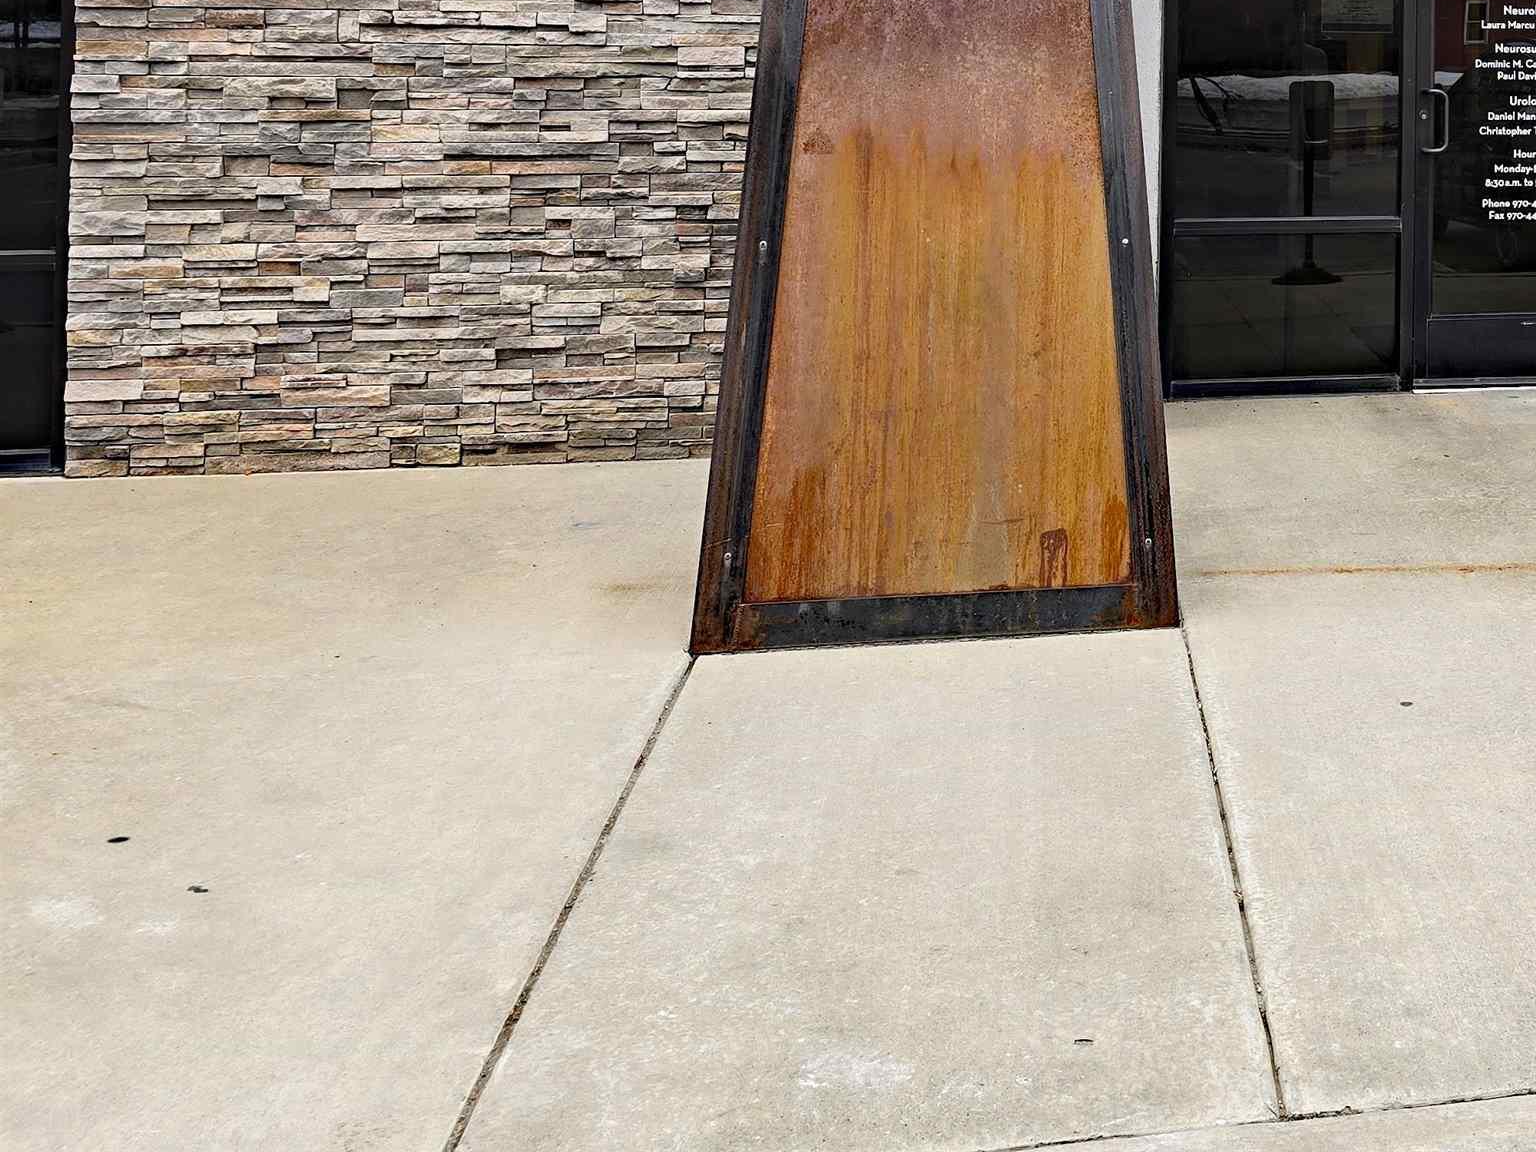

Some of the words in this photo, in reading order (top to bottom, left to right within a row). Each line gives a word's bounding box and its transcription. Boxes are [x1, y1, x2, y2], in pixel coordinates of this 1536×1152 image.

[1481, 20, 1506, 29] Laura
[1508, 20, 1535, 29] Marcu
[1475, 59, 1511, 68] Dominic
[1512, 59, 1523, 68] M.
[1497, 70, 1516, 80] Paul
[1487, 111, 1516, 120] Daniel
[1479, 125, 1532, 137] Christopher
[1524, 177, 1534, 187] to
[1482, 198, 1511, 208] Phone
[1488, 210, 1505, 220] Fax
